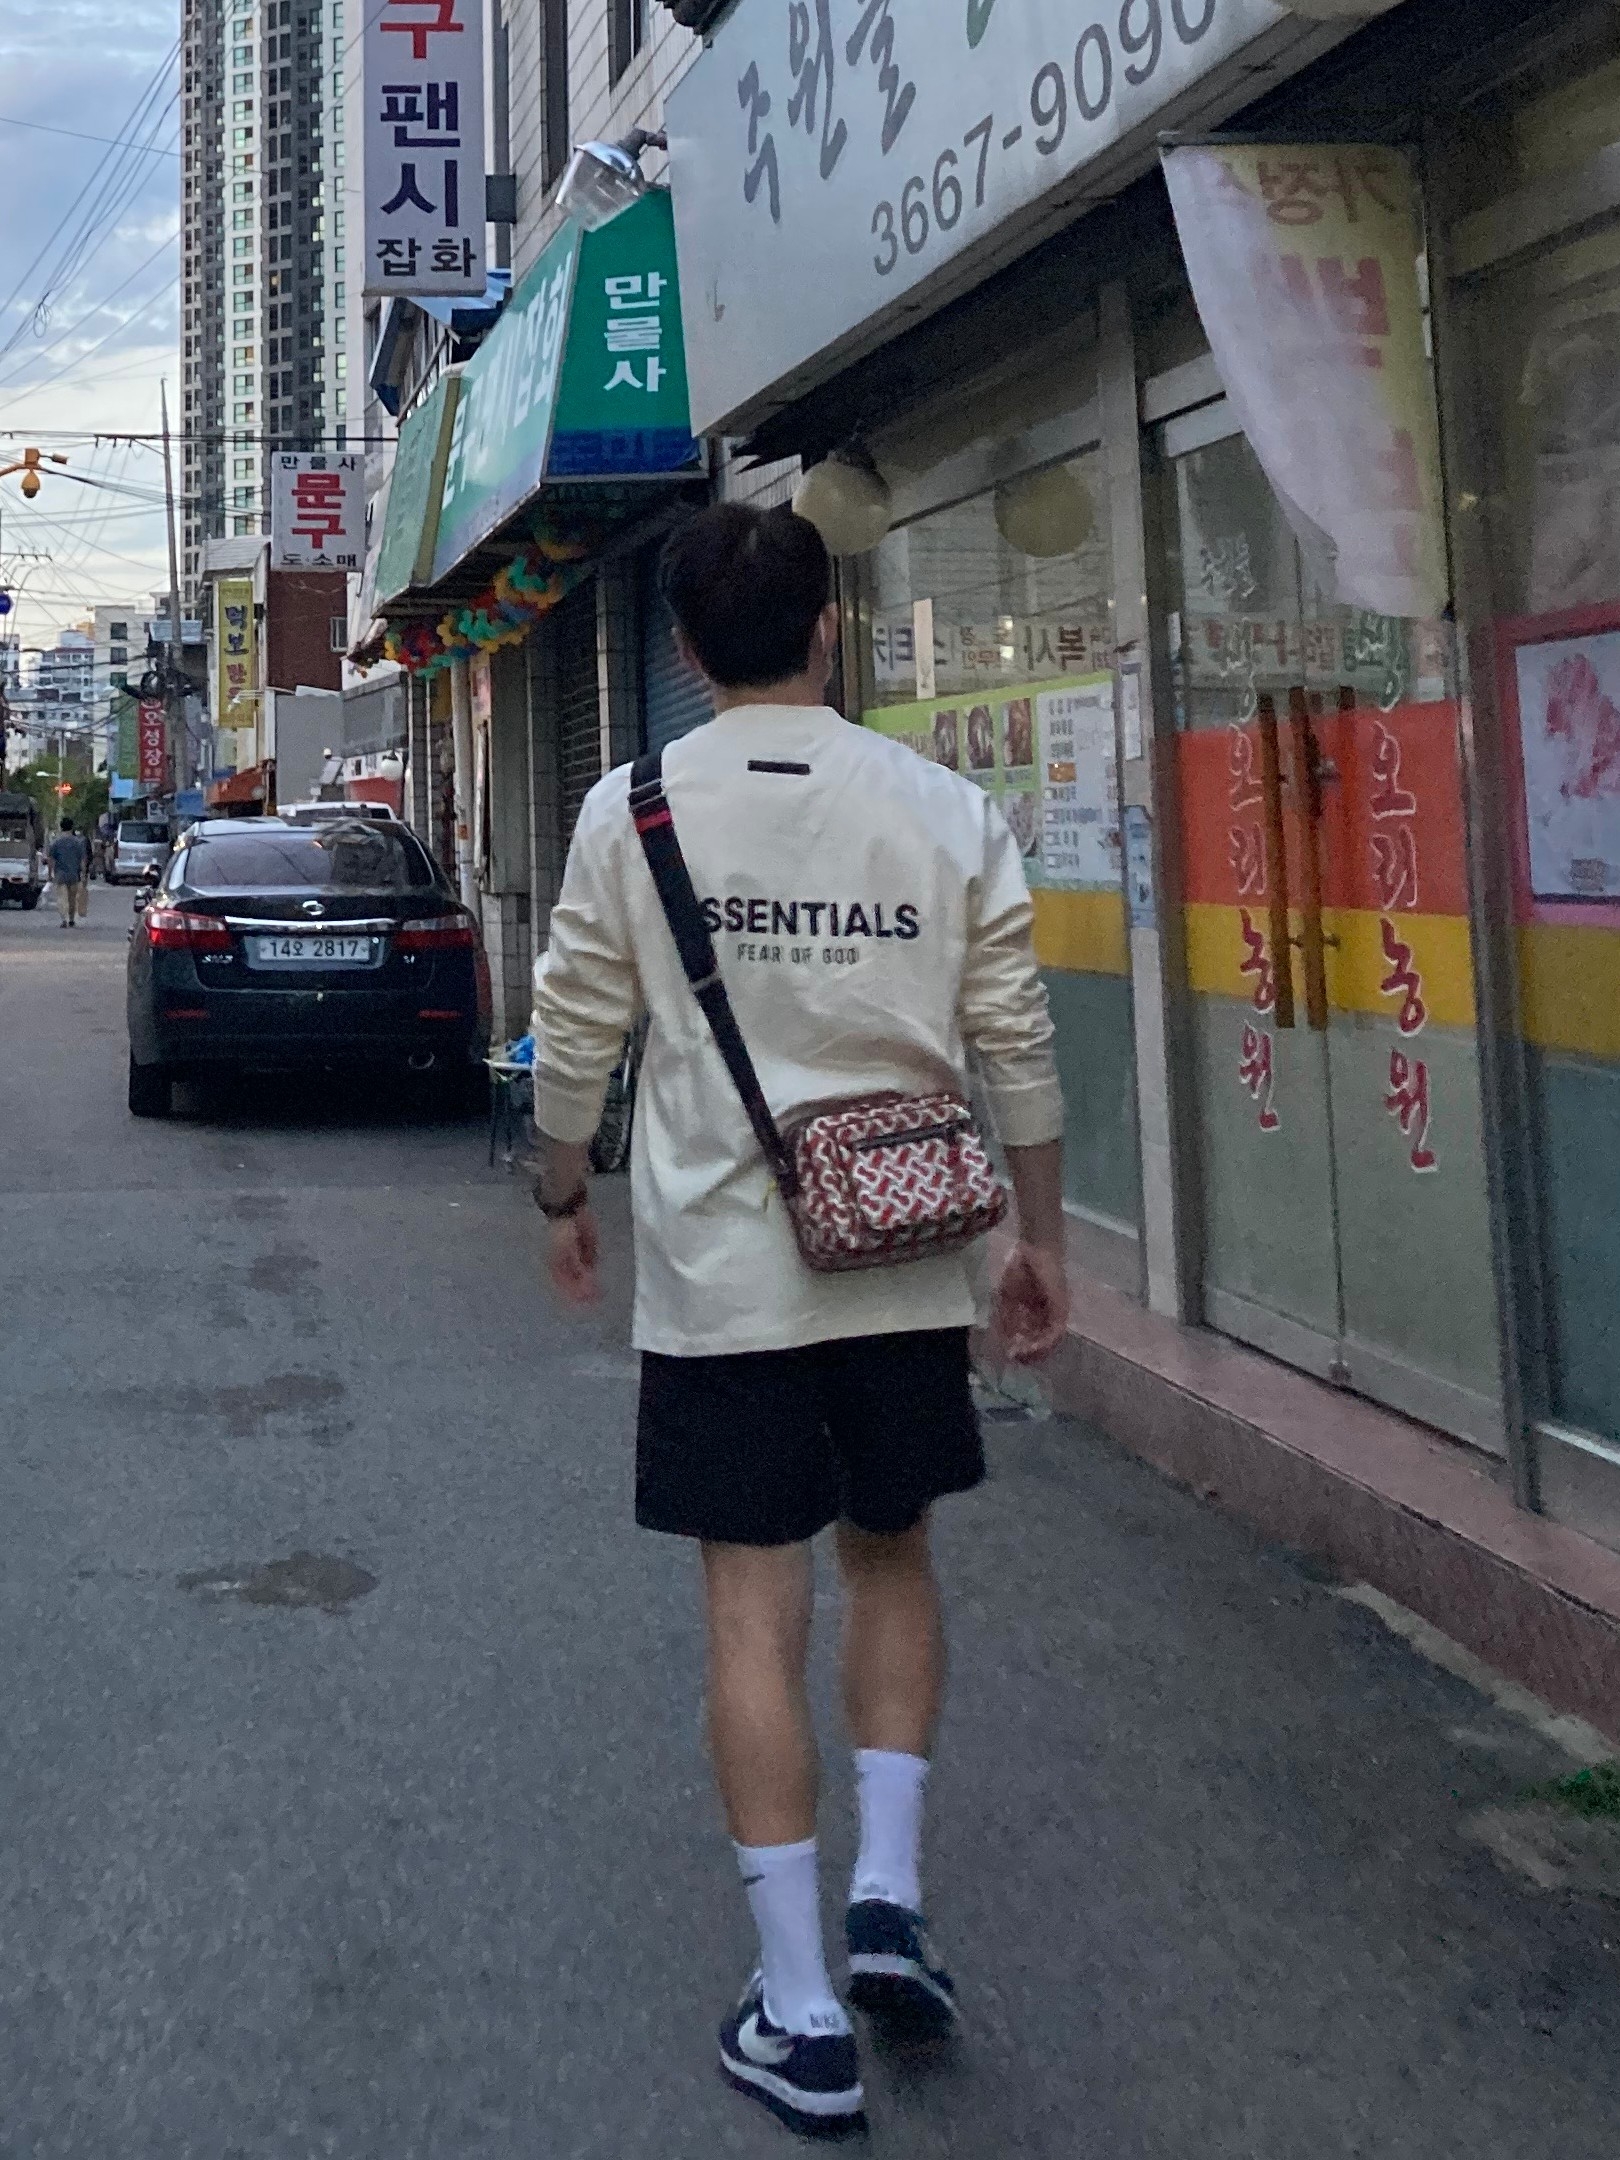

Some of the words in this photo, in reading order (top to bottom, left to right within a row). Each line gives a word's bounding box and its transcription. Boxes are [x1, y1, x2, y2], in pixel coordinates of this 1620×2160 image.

[379, 81, 462, 228] 팬시
[376, 236, 478, 278] 잡화
[603, 271, 668, 392] 만물사
[291, 472, 347, 550] 문구
[700, 896, 921, 940] SSENTIALS
[312, 940, 360, 958] 2817
[737, 943, 782, 965] FEAR
[790, 947, 814, 965] OF
[822, 947, 860, 966] GOD
